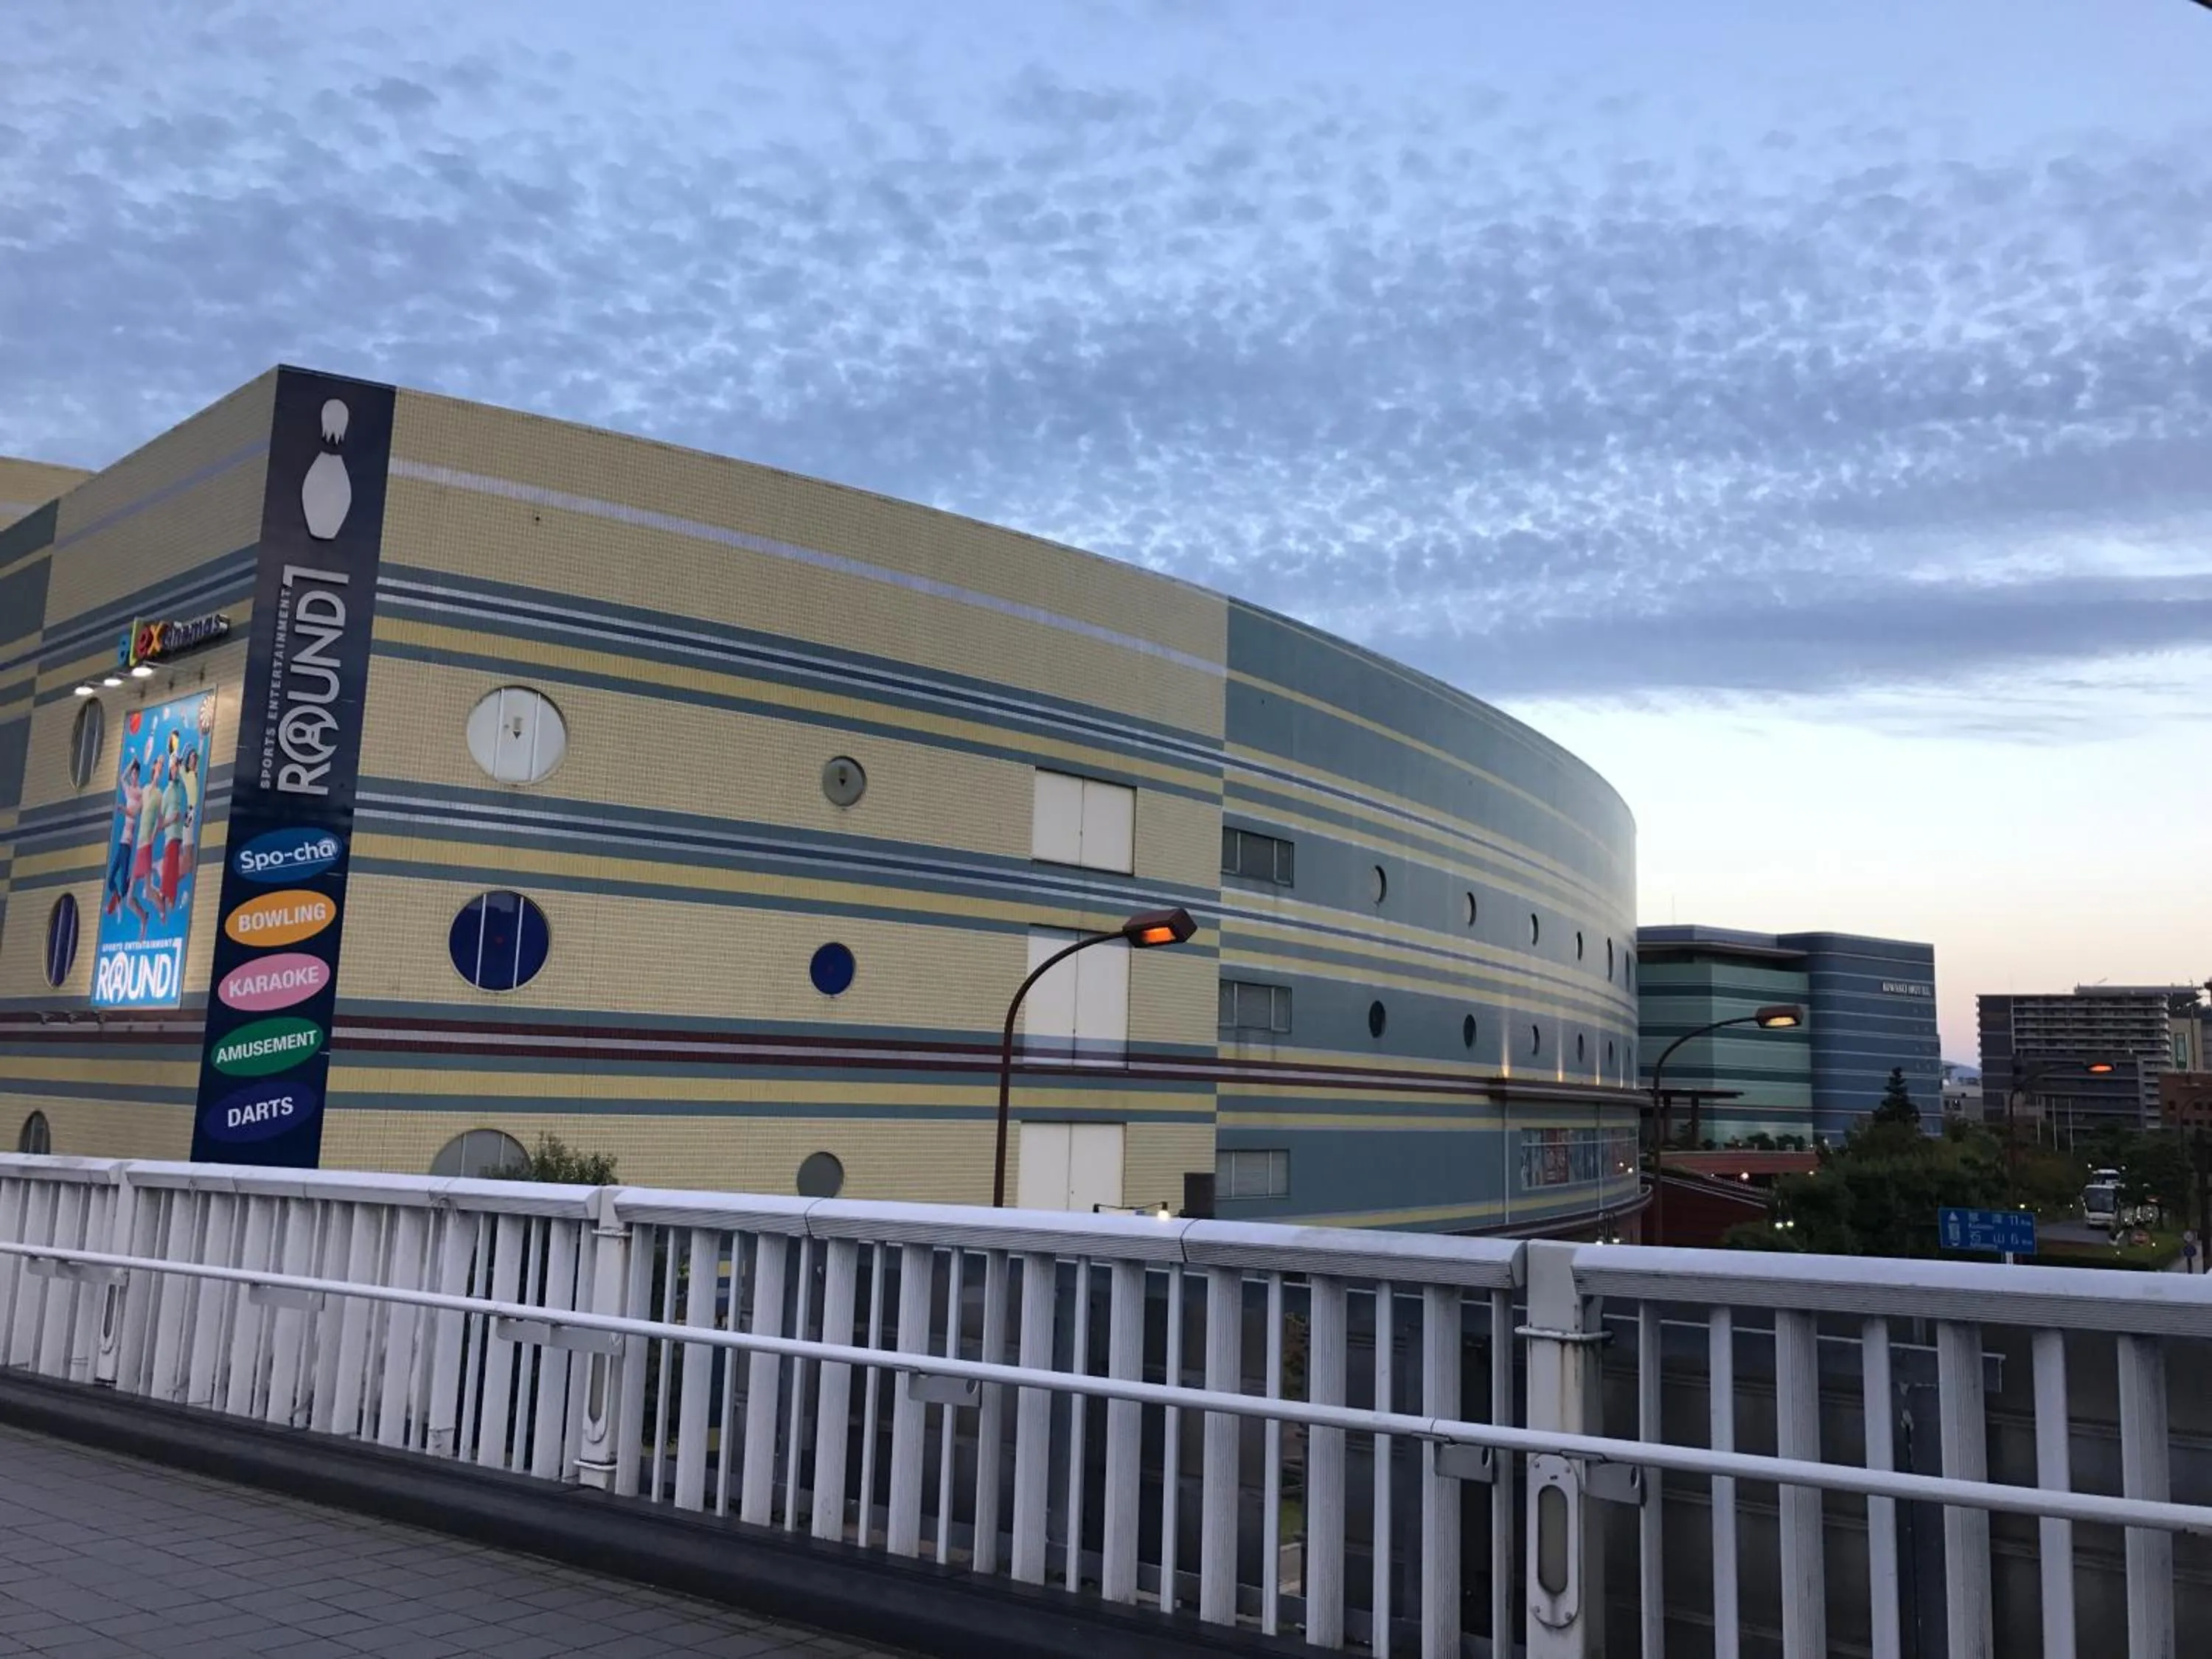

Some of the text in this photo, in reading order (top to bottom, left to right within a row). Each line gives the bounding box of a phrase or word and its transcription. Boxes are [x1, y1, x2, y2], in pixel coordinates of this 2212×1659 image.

[260, 588, 291, 790] SPORTS ENTERTAINMENT
[277, 564, 349, 796] ROUND1
[240, 839, 336, 871] Spo-cha
[237, 902, 327, 933] BOWLING
[229, 965, 320, 998] KARAOKE
[215, 1029, 317, 1064] AMUSEMENT
[227, 1096, 295, 1128] DARTS
